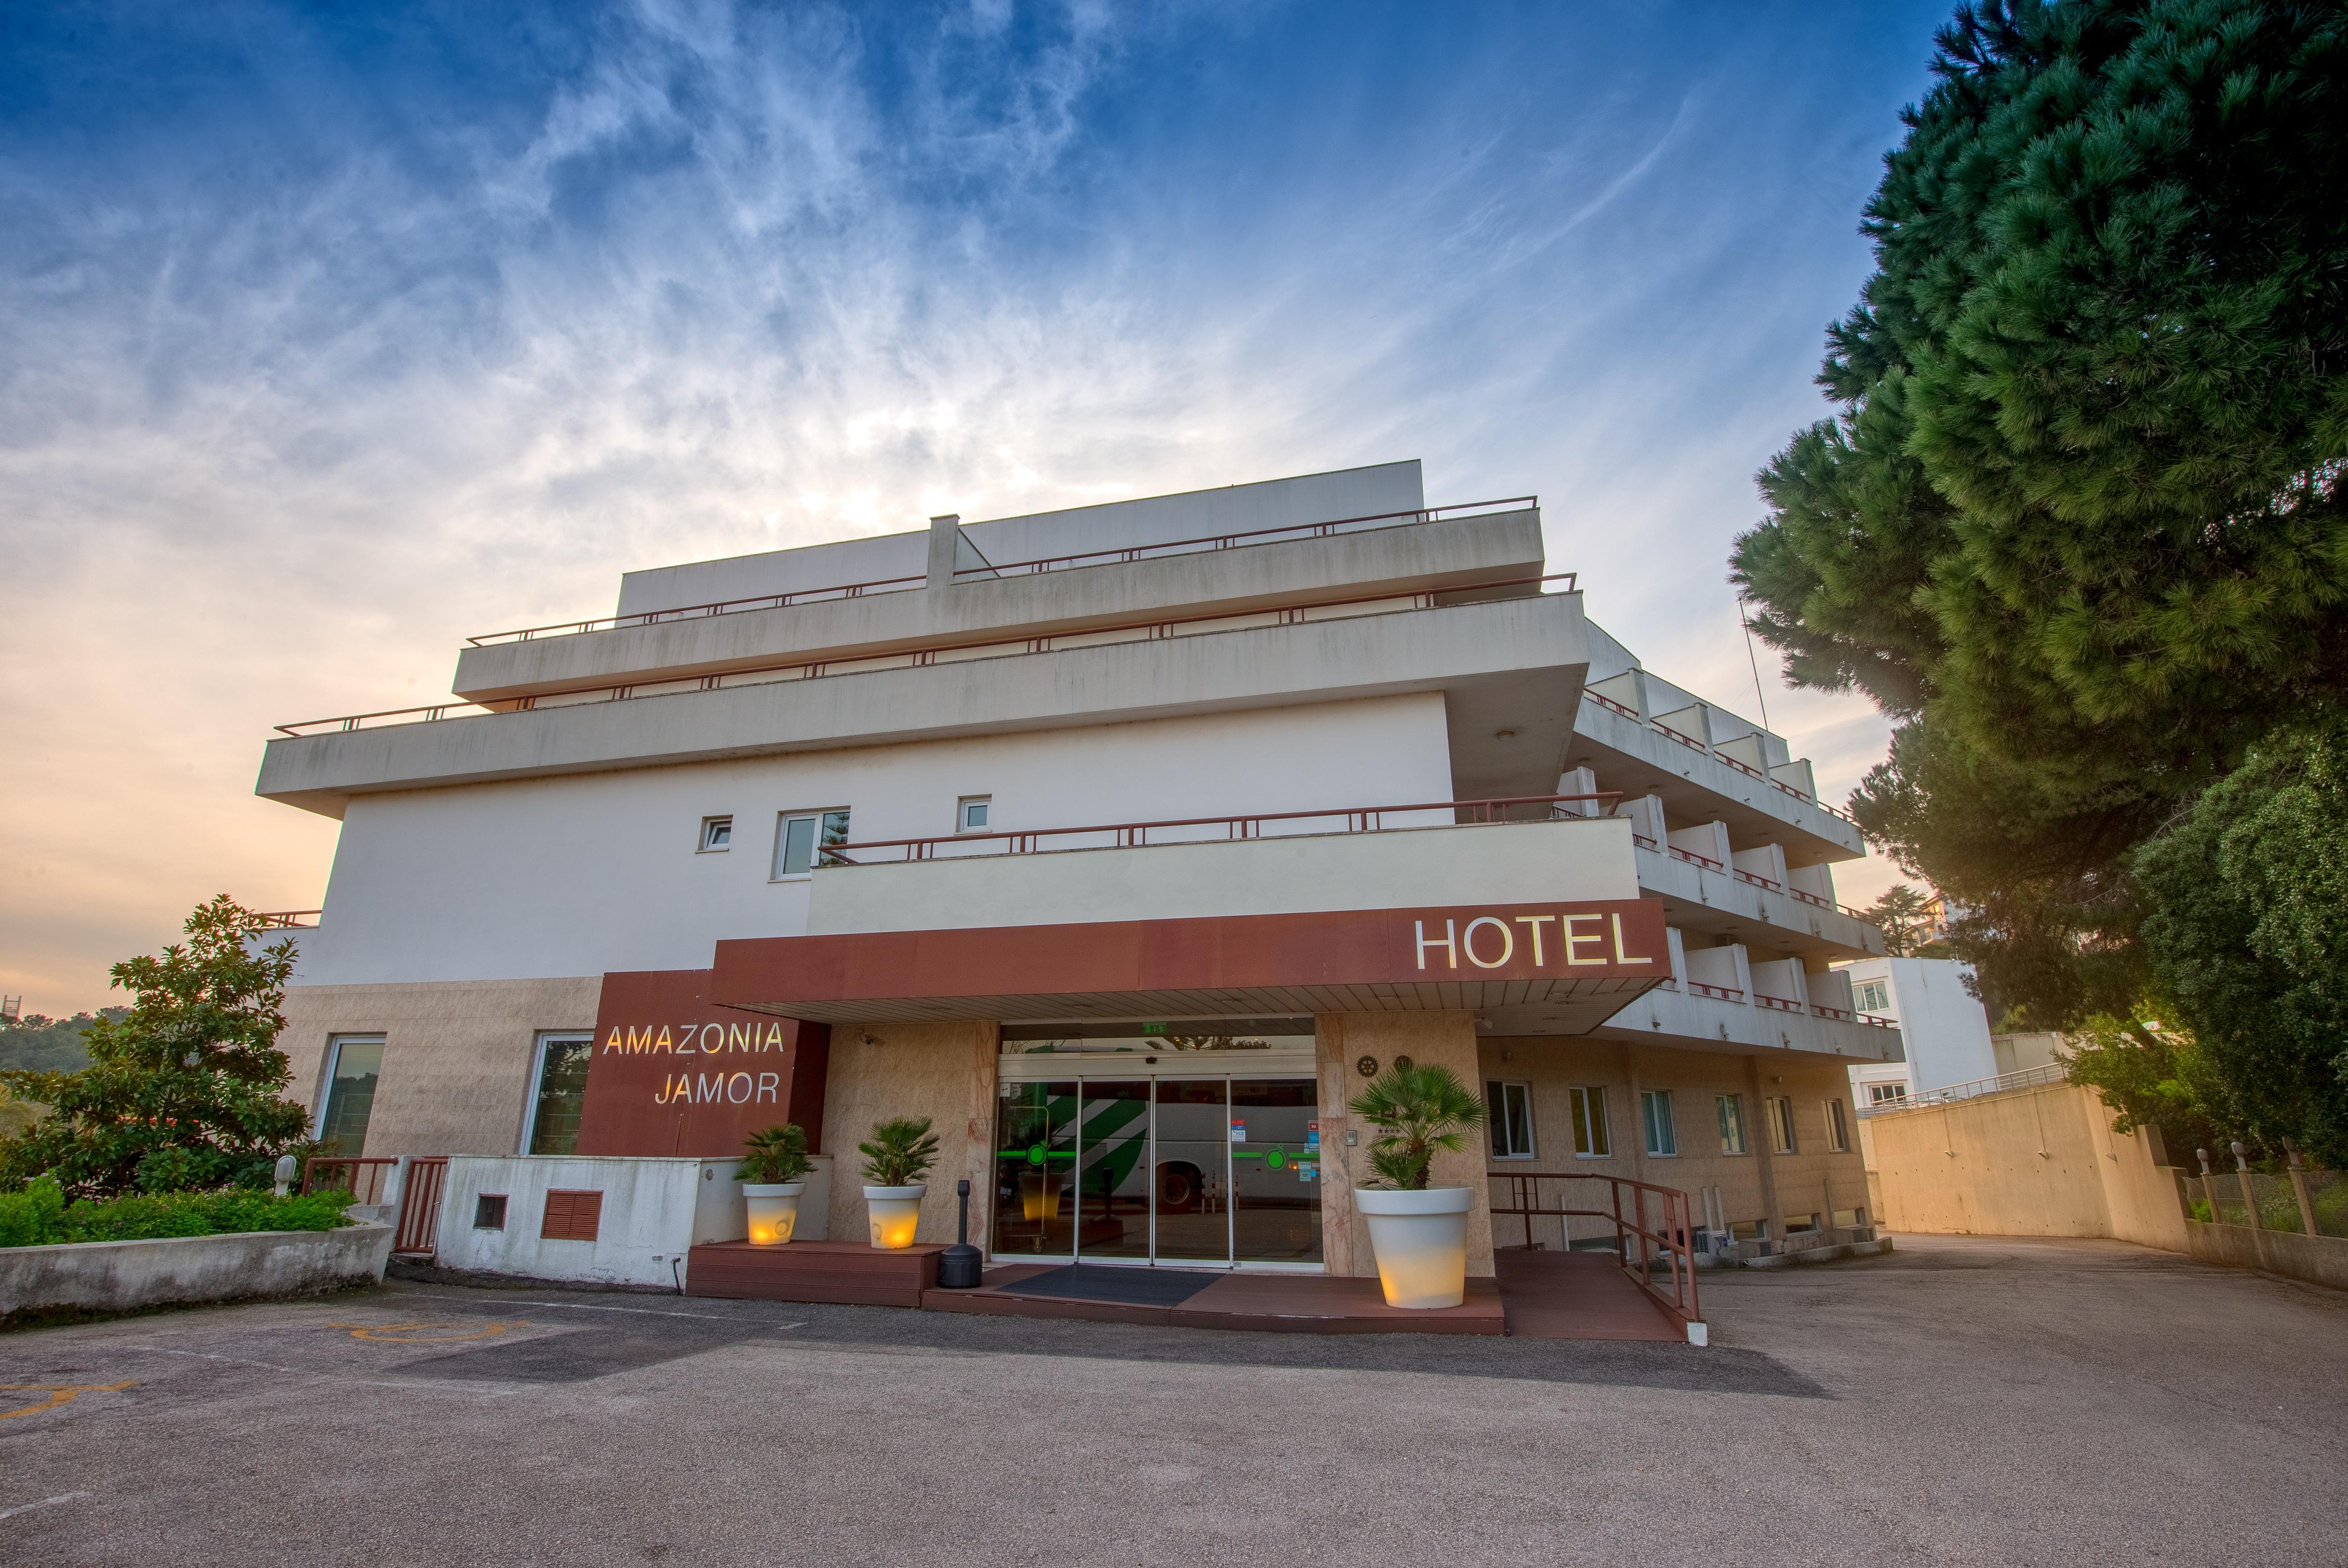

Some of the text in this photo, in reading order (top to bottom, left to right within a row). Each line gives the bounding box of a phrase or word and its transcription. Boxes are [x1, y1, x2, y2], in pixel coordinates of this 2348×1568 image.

[1415, 913, 1652, 970] HOTEL
[602, 1022, 784, 1055] AMAZONIA
[655, 1072, 780, 1104] JAMOR
